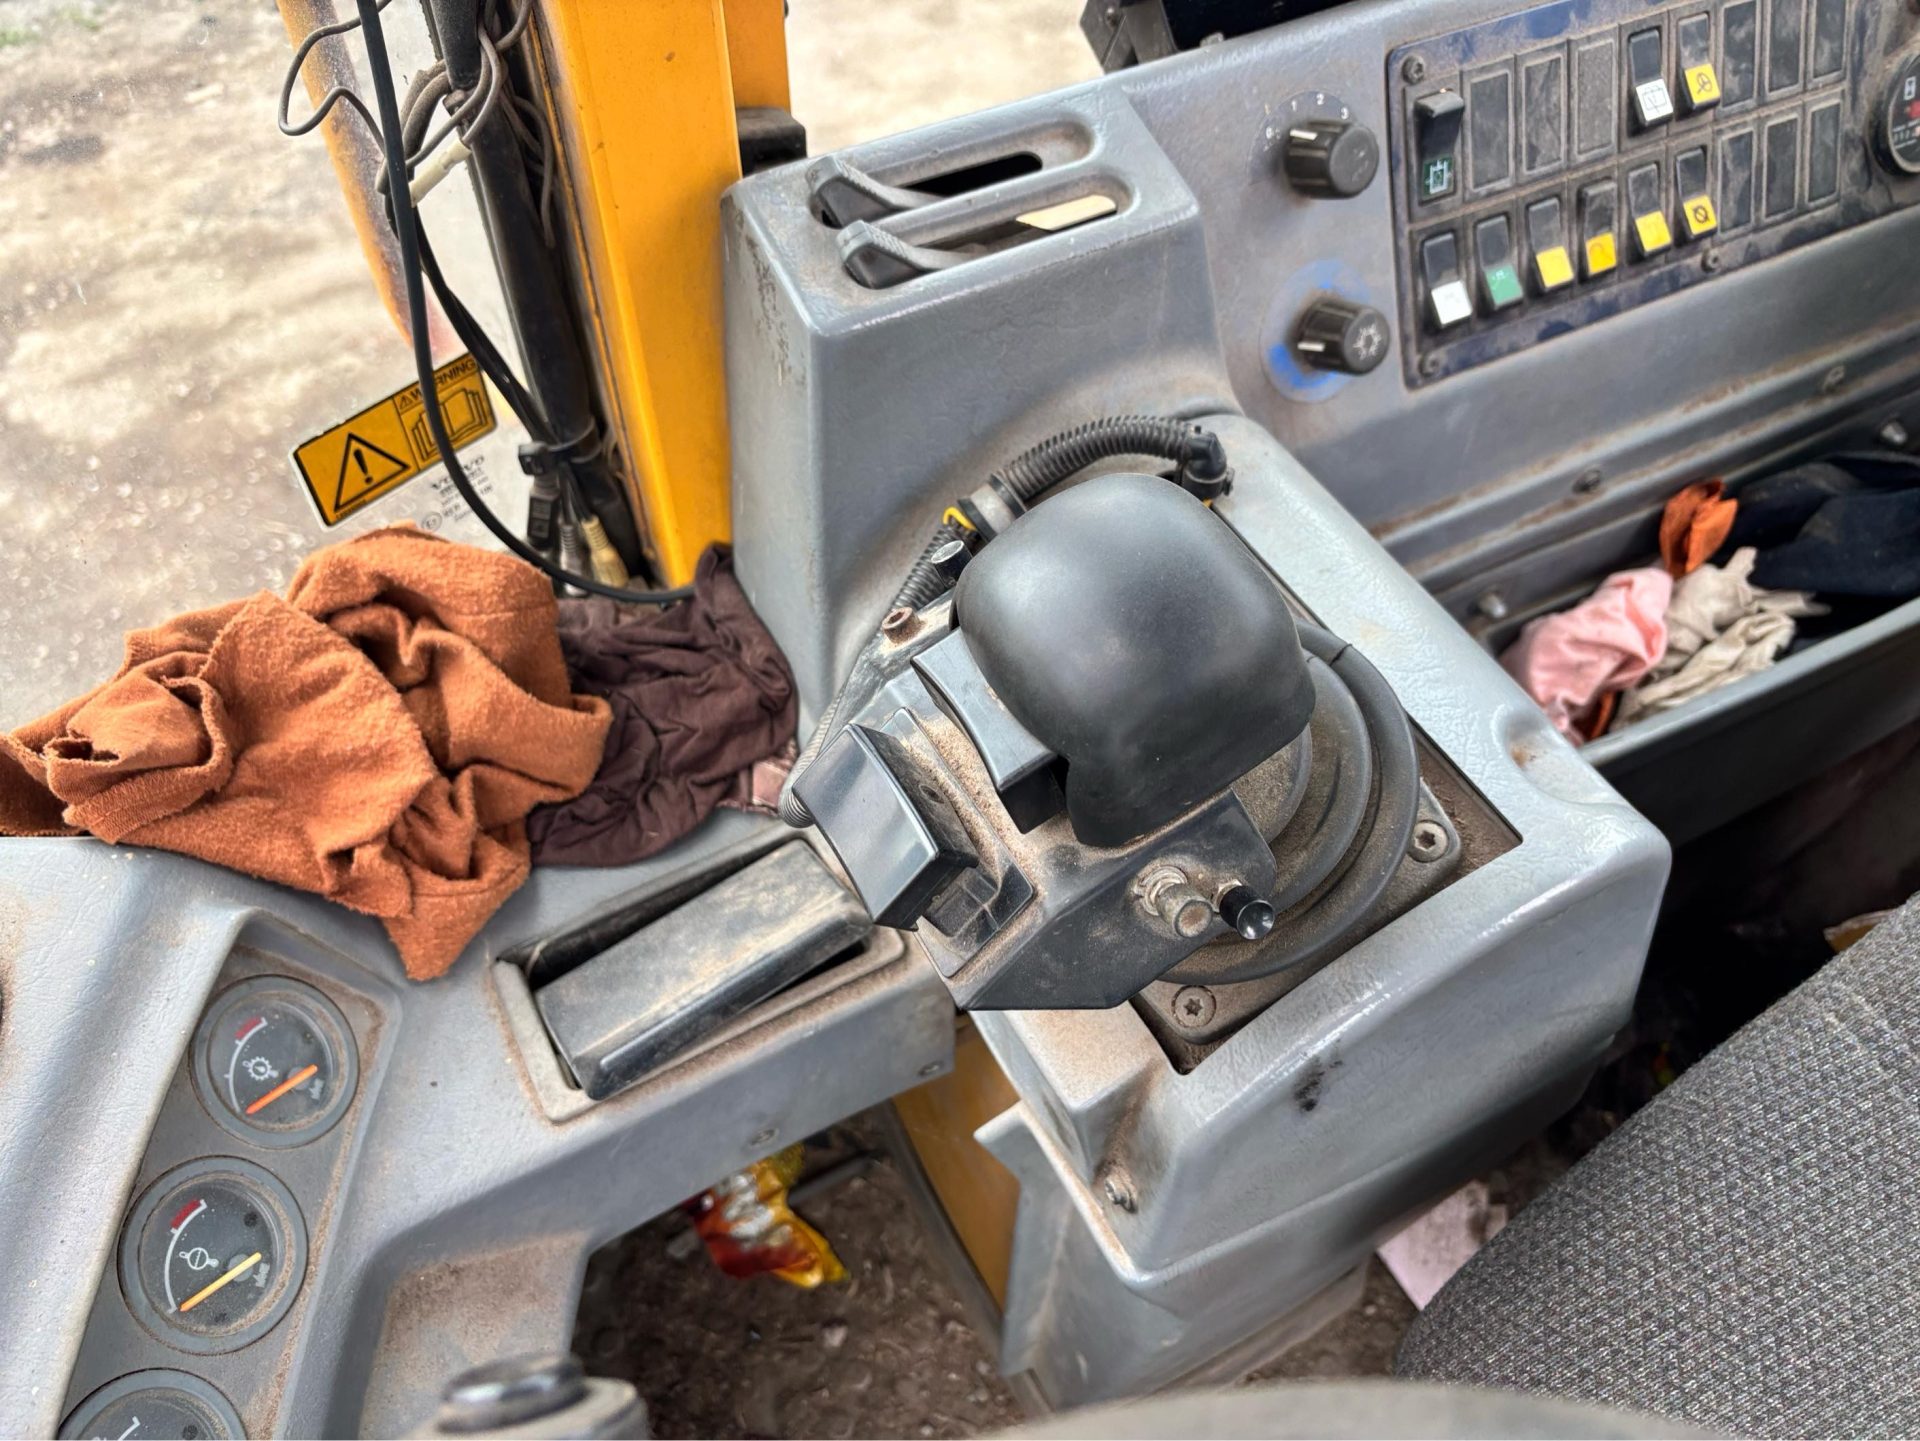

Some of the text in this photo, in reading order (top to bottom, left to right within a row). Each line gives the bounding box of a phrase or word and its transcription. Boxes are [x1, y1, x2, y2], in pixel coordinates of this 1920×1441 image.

[1290, 100, 1297, 112] 1
[1316, 93, 1324, 105] 2
[1340, 107, 1348, 120] 3
[410, 358, 477, 401] WRNING
